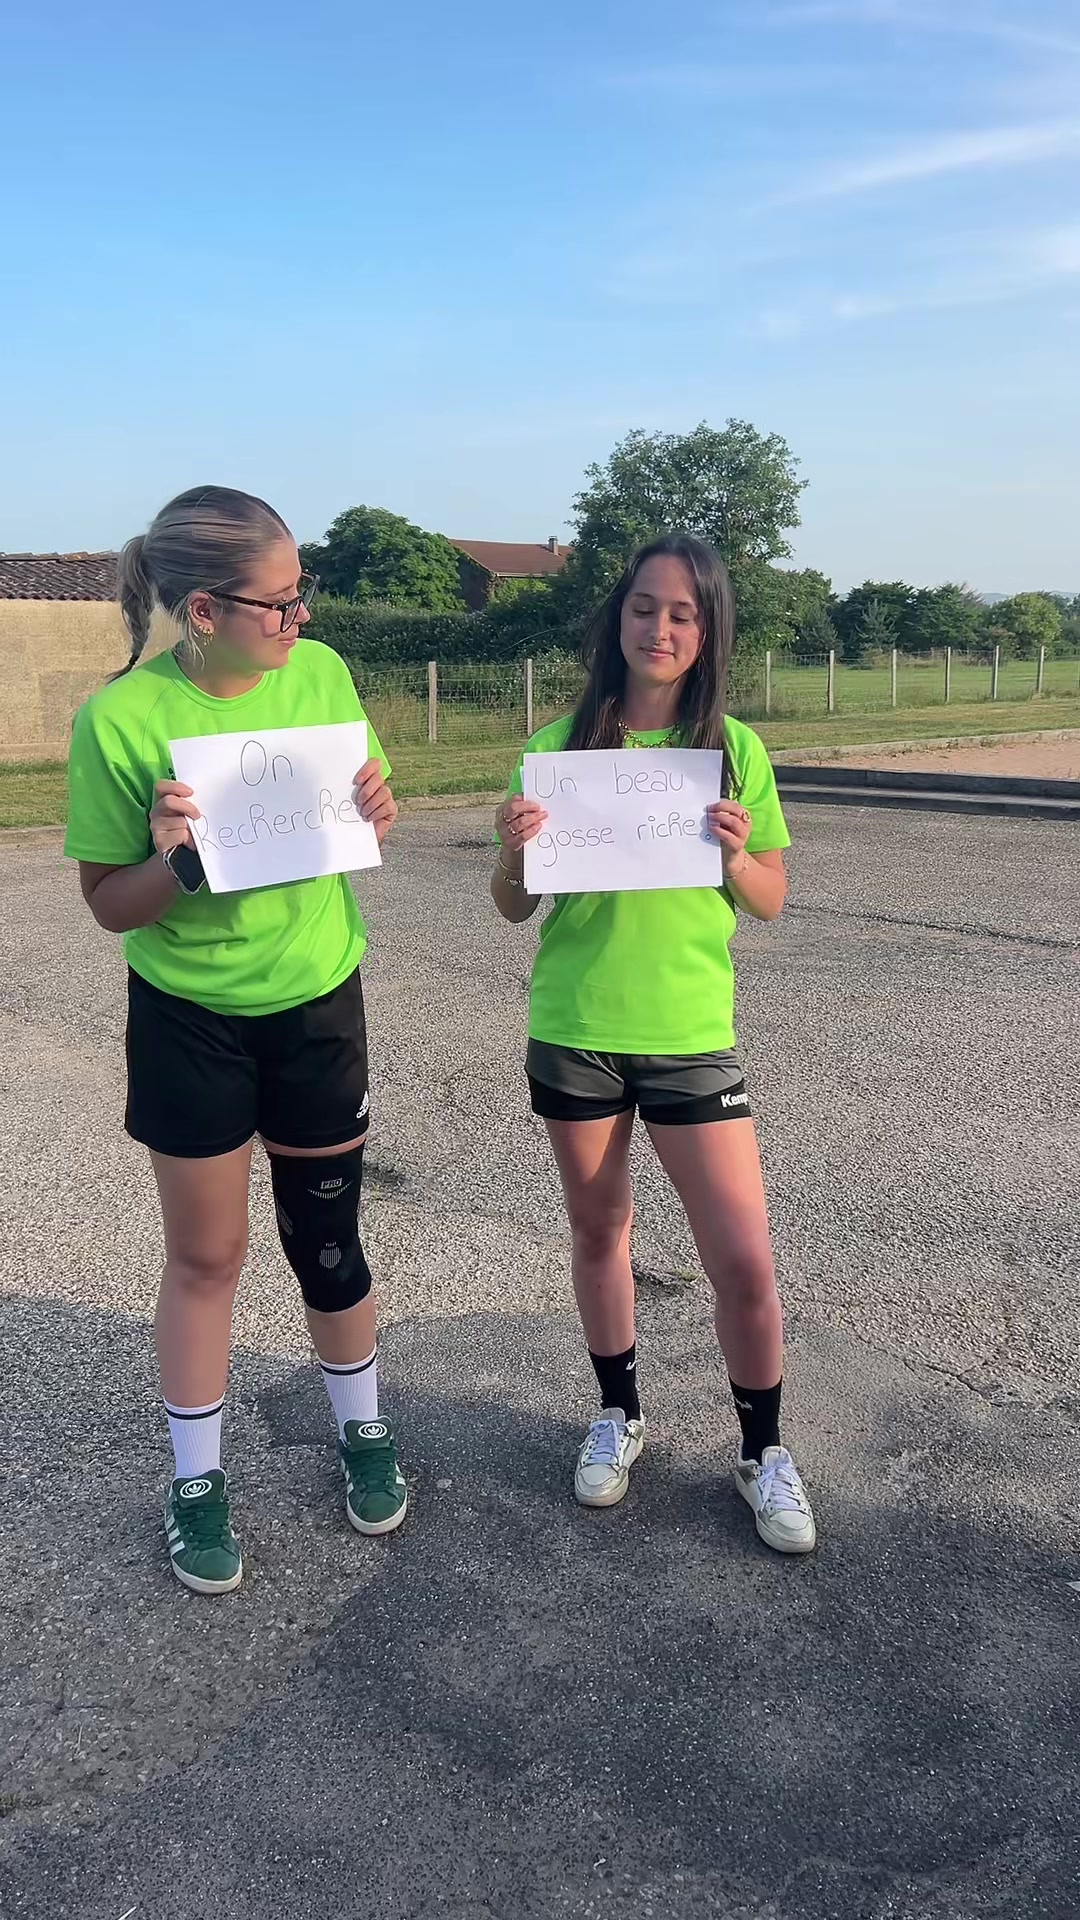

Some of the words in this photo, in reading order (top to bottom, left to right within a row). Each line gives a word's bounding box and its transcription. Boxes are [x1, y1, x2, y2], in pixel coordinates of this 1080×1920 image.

[240, 739, 294, 787] On
[534, 764, 578, 799] Un
[612, 762, 684, 795] beau
[193, 788, 360, 852] Recherche
[536, 826, 615, 868] gosse
